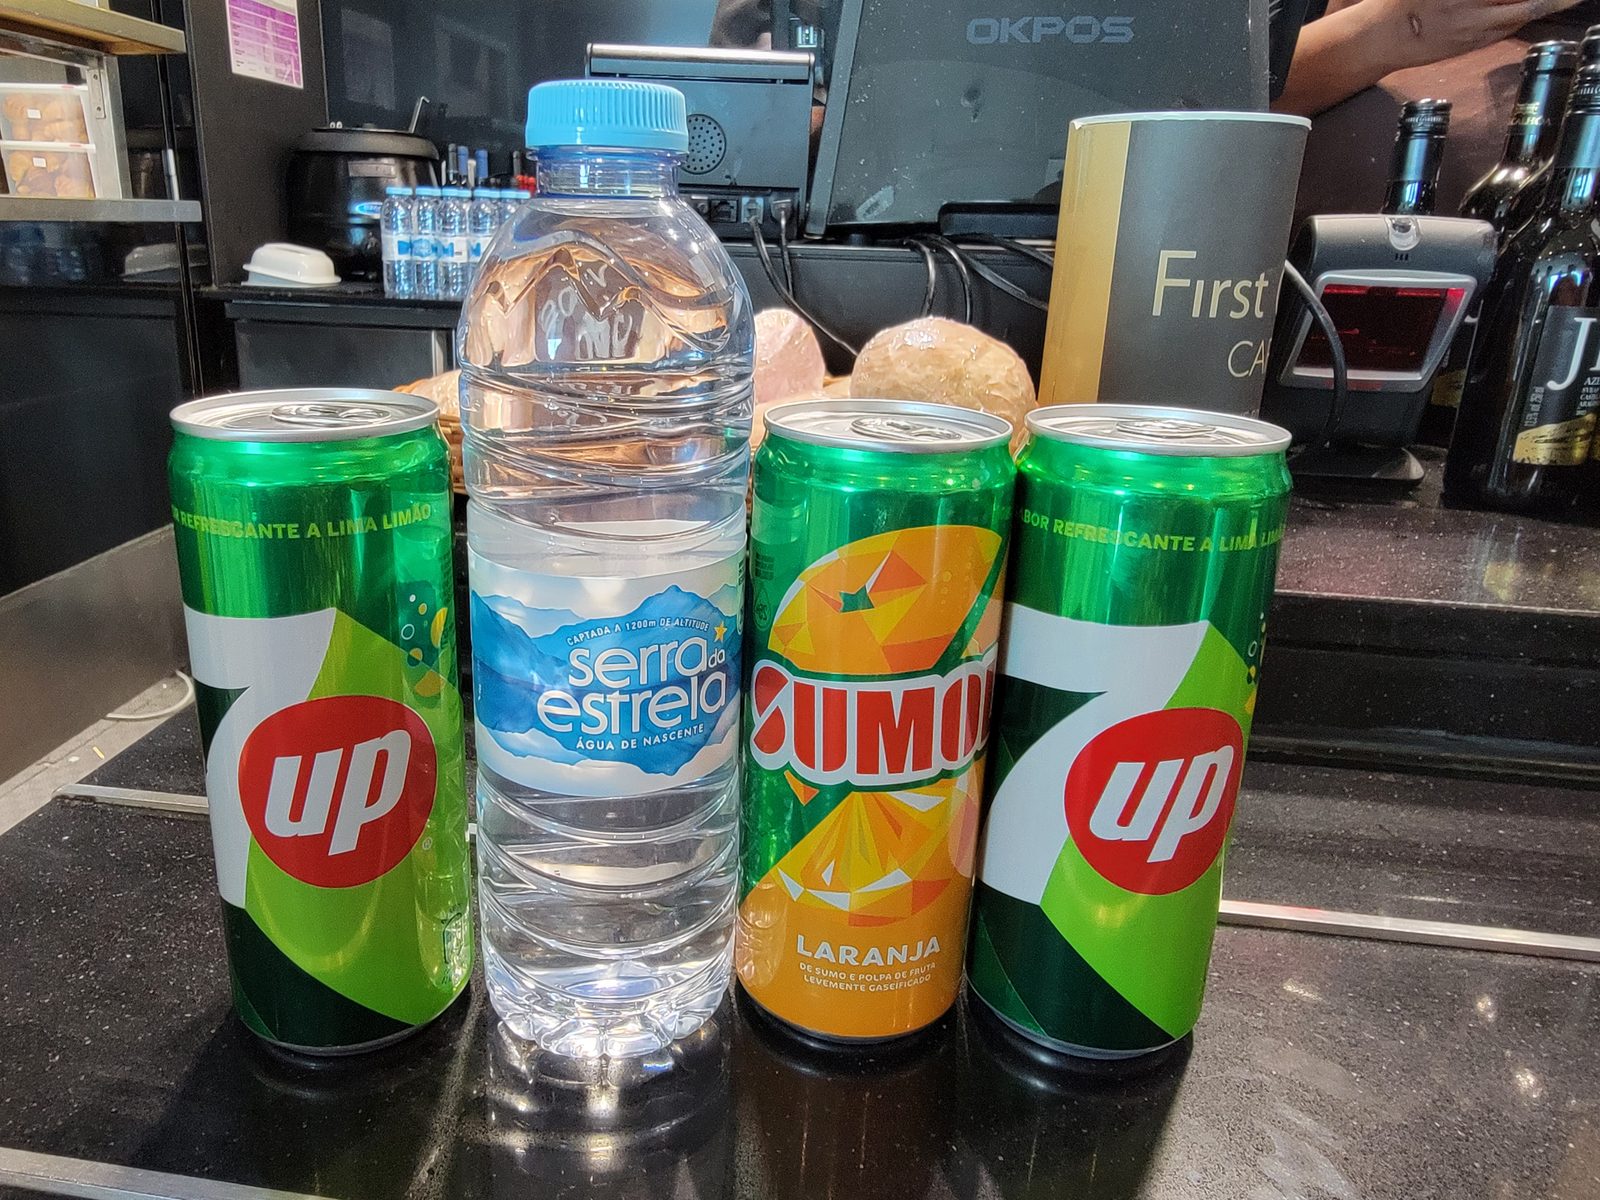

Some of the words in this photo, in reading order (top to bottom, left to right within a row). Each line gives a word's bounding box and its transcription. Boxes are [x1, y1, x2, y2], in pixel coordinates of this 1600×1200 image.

[966, 15, 1136, 45] OKPOS
[1152, 250, 1269, 319] First
[1547, 317, 1600, 391] J
[180, 510, 300, 540] REFRESCANTE
[306, 523, 321, 538] A
[328, 516, 378, 537] LIMA
[382, 503, 431, 530] LIMÃO
[1021, 508, 1050, 531] BOR
[1053, 518, 1196, 552] REFRESCANTE
[1200, 536, 1214, 552] A
[566, 626, 611, 647] CAPTADA
[614, 623, 622, 633] A
[625, 618, 656, 631] 1200m
[660, 617, 671, 627] DE
[673, 618, 710, 632] ALTITUDE
[568, 636, 708, 689] serra
[708, 648, 726, 669] da
[537, 671, 726, 735] estrela
[576, 736, 615, 750] ÁGUA
[621, 738, 637, 749] DE
[643, 723, 704, 747] NASCENTE
[796, 934, 941, 967] LARANJA
[799, 962, 812, 973] DE
[815, 965, 846, 980] SUMO
[849, 973, 856, 981] E
[858, 972, 892, 982] POLPA
[895, 970, 907, 980] DE
[909, 962, 936, 977] FRUTA
[803, 974, 866, 992] LEVEMENTE
[869, 973, 932, 992] GASEIFICADO
